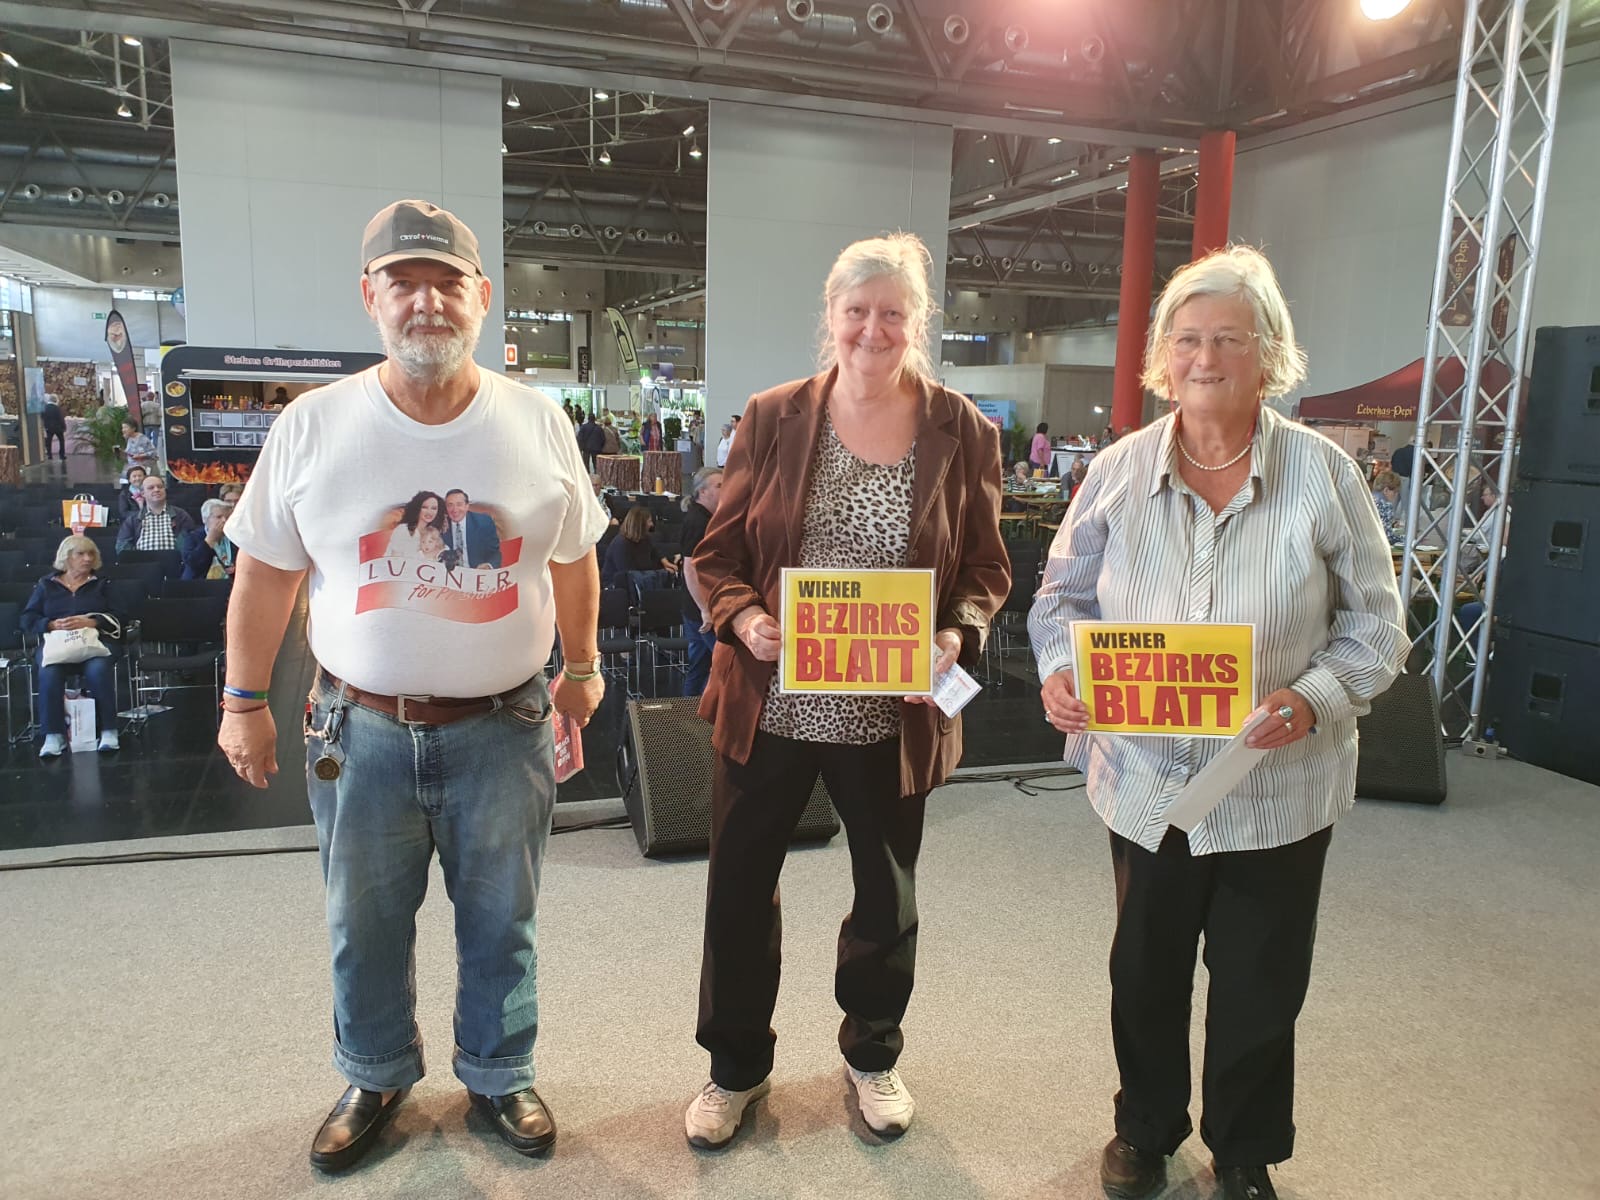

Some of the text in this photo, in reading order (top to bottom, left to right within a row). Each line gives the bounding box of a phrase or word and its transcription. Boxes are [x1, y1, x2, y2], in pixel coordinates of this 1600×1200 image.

[368, 559, 511, 592] LUGNER
[798, 581, 861, 599] WIENER
[408, 584, 433, 601] for
[796, 602, 920, 636] BEZIRKS
[1090, 632, 1166, 649] WIENER
[796, 638, 920, 683] BLATT
[1090, 652, 1239, 684] BEZIRKS
[1093, 684, 1239, 728] BLATT
